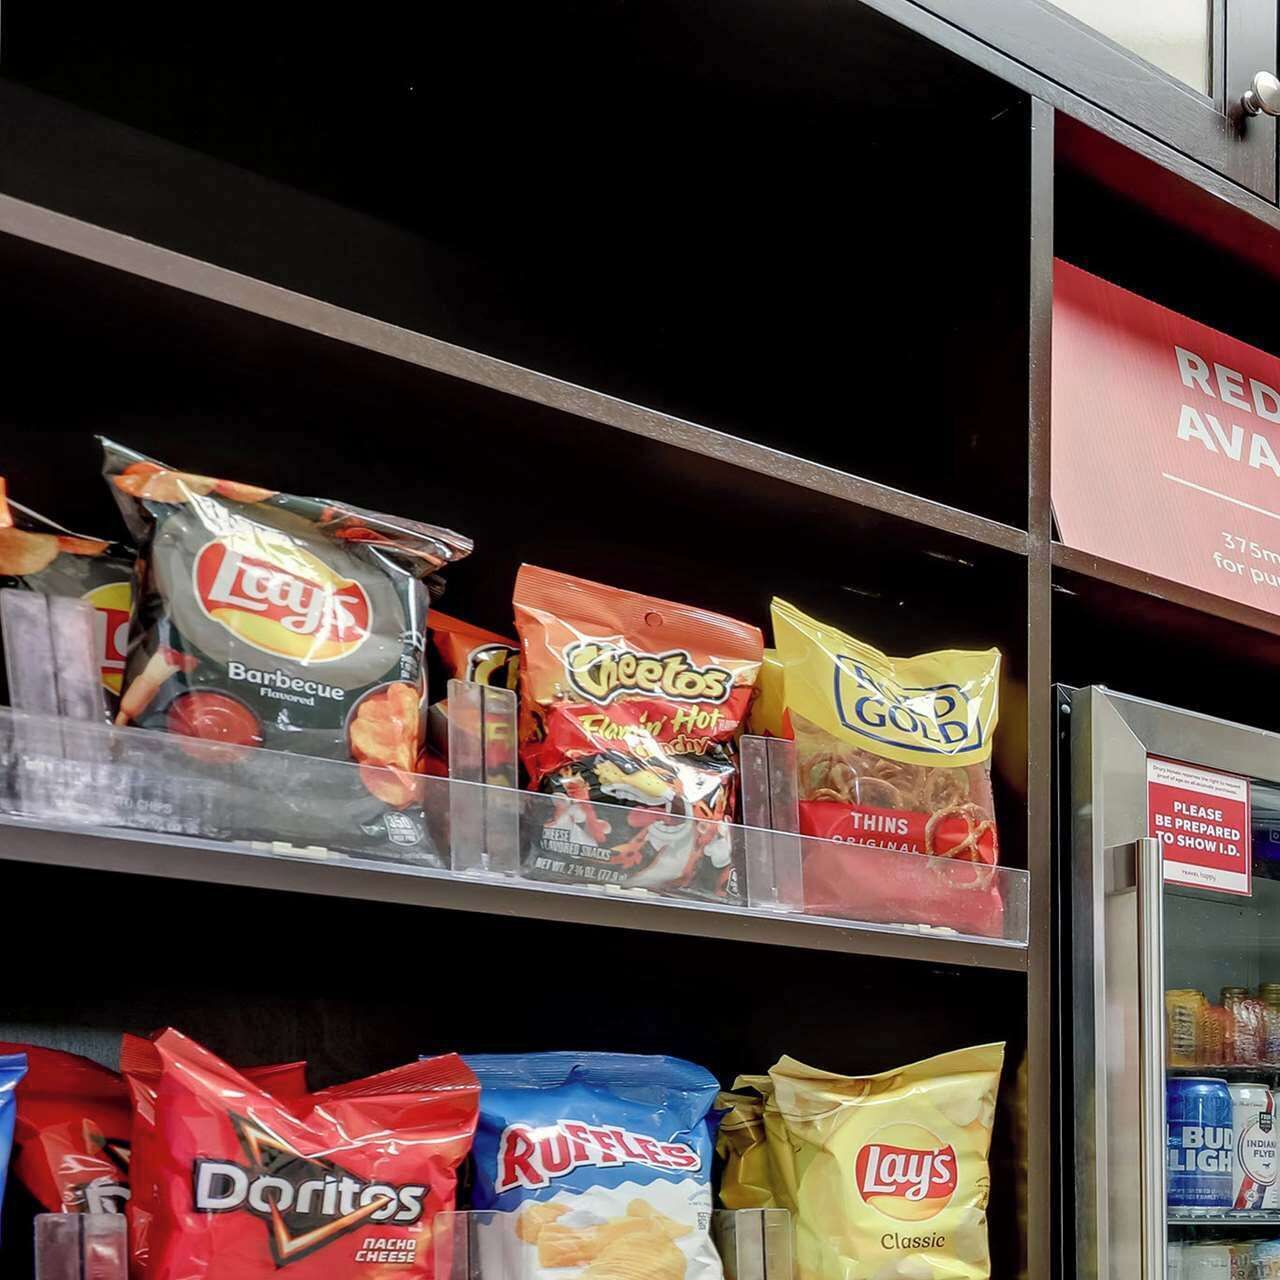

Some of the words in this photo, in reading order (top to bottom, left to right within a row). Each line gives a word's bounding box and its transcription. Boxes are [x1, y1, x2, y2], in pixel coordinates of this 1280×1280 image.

[1213, 552, 1245, 576] for
[227, 660, 346, 702] Barbecue
[569, 643, 731, 703] Cheetos
[260, 686, 316, 708] Flavored
[672, 705, 724, 733] Hot
[853, 696, 970, 746] GOLD
[1173, 801, 1223, 822] PLEASE
[850, 812, 910, 836] THINS
[1155, 815, 1172, 828] BE
[1174, 819, 1241, 842] PREPARED
[831, 834, 920, 856] ORIGINAL
[1156, 831, 1175, 844] TO
[1177, 836, 1217, 854] SHOW
[1219, 843, 1241, 857] I.D.
[1182, 1127, 1233, 1149] BUD
[1246, 1140, 1276, 1149] INDIAN
[499, 1123, 698, 1188] RUFFLES
[1170, 1150, 1233, 1172] LIGH
[1253, 1150, 1276, 1159] FLYE
[863, 1146, 954, 1201] Lay's
[194, 1159, 426, 1222] Doritos
[363, 1238, 417, 1252] NACHO
[880, 1232, 946, 1250] Classic
[355, 1251, 417, 1264] CHEESE
